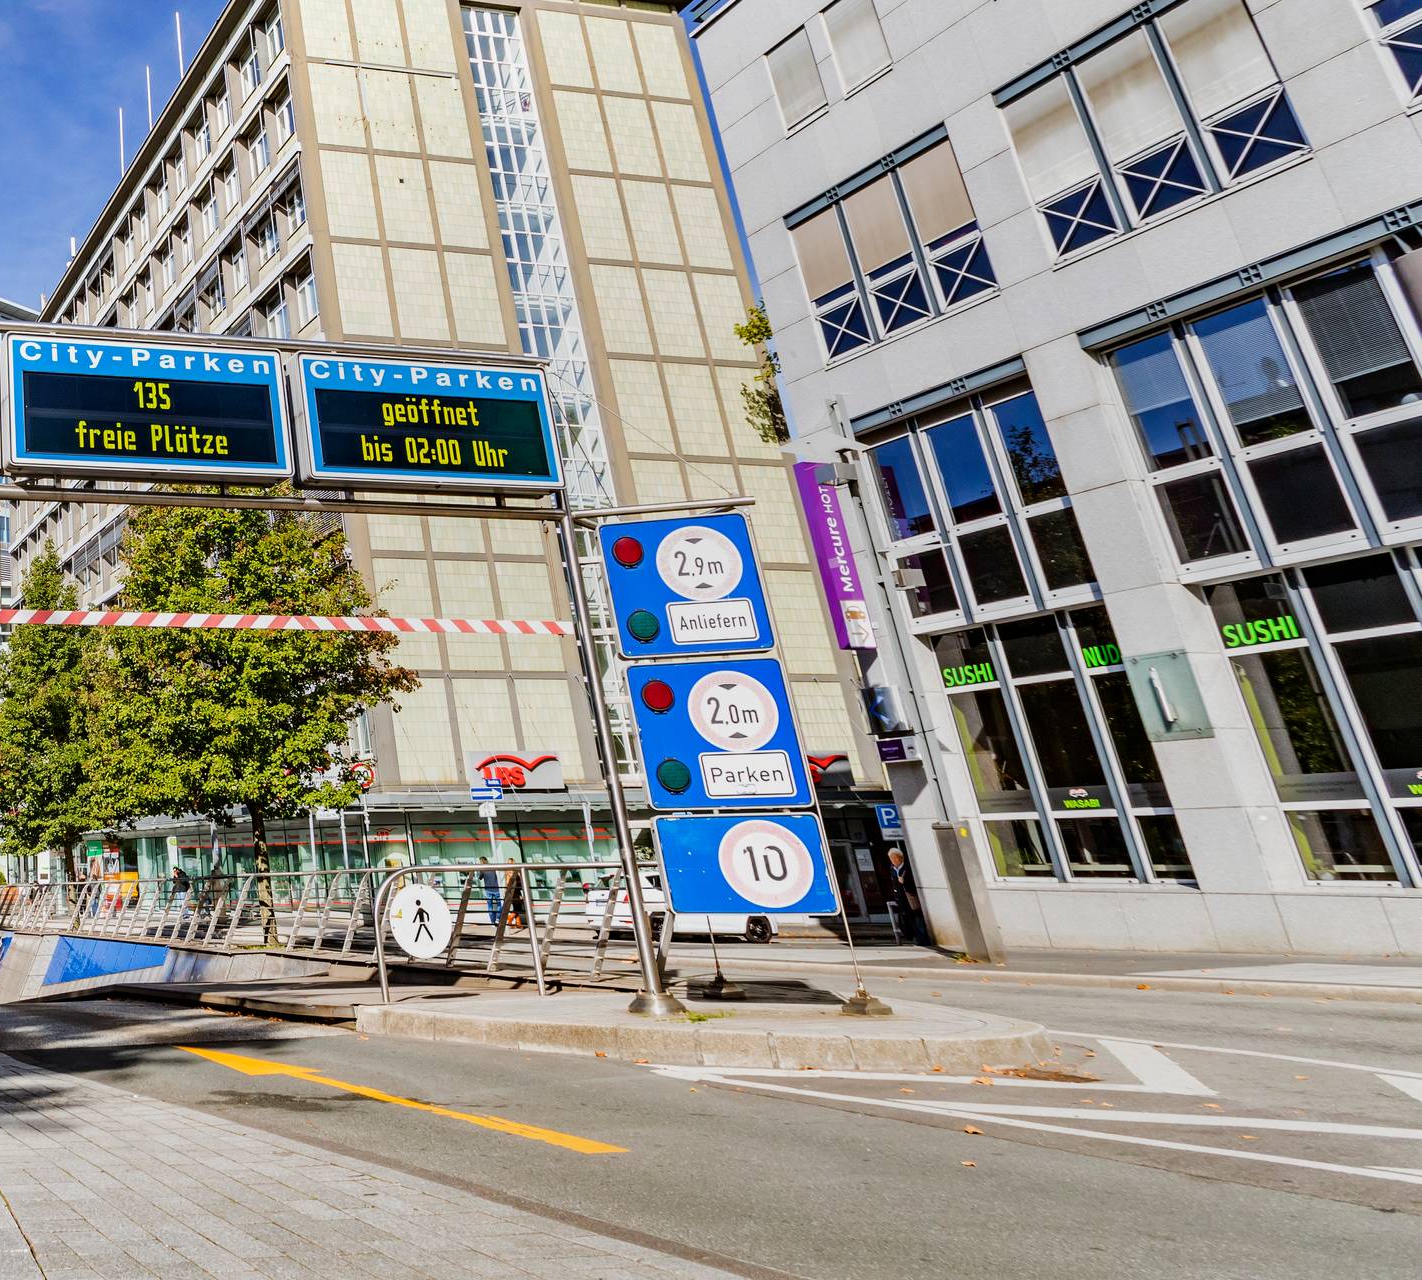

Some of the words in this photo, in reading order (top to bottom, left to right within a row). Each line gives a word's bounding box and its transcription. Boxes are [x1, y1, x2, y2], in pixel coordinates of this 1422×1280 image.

[19, 341, 270, 375] City-Parken
[309, 360, 538, 392] City-Parken
[133, 381, 172, 410] 135
[382, 397, 480, 427] geöffnet
[75, 420, 137, 451] freie
[150, 424, 229, 455] Plätze
[360, 434, 393, 463] bis
[404, 437, 462, 466] 02:00
[472, 440, 508, 468] Uhr
[826, 517, 855, 593] Mercure
[680, 613, 747, 631] Anliefern
[1221, 615, 1301, 648] SUSHI
[942, 662, 996, 687] SUSHI
[710, 765, 784, 783] Parken
[1063, 798, 1101, 809] WASABI
[743, 846, 788, 882] 10
